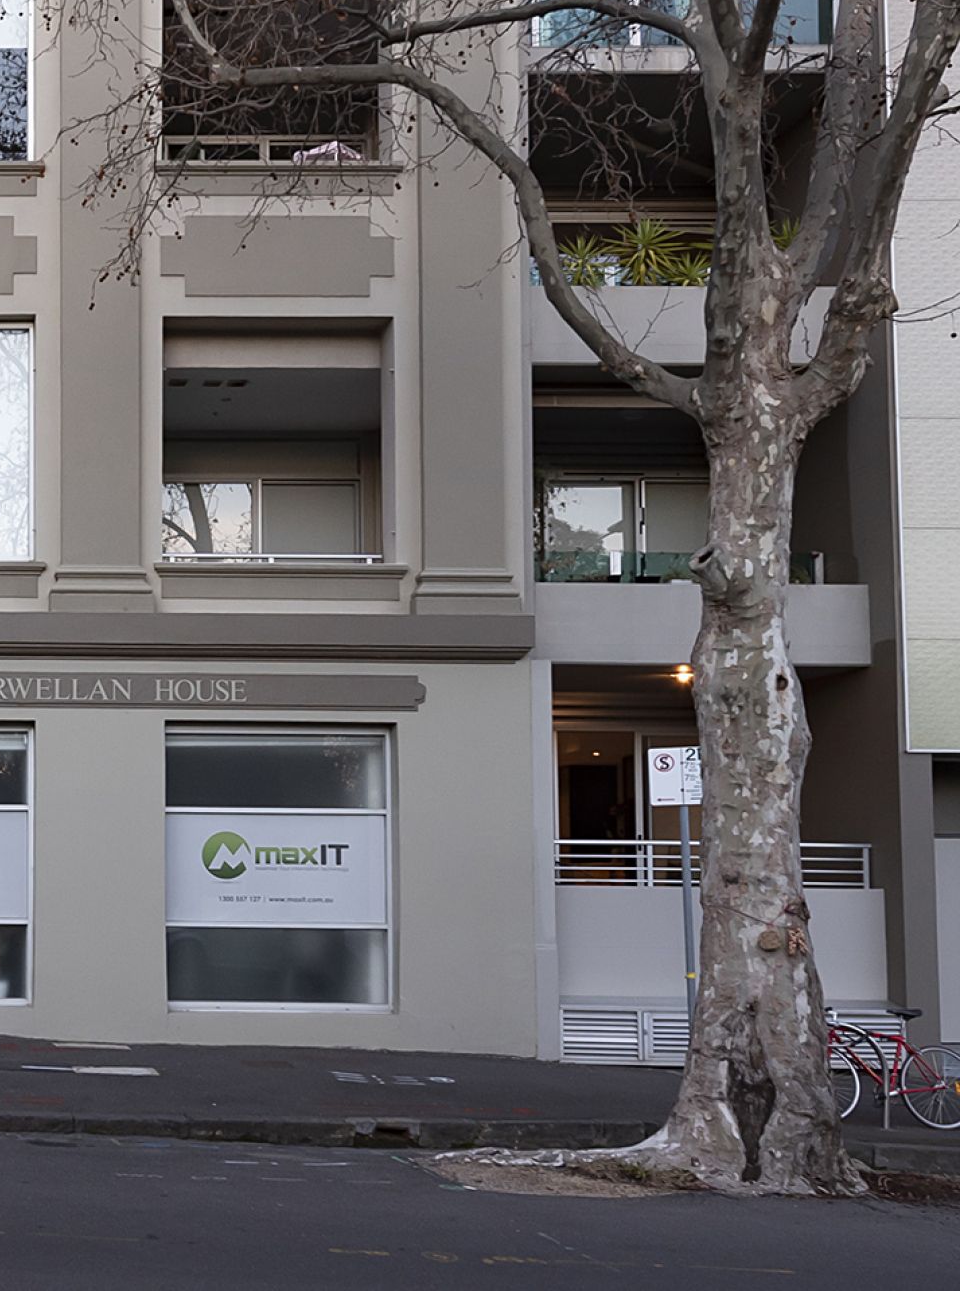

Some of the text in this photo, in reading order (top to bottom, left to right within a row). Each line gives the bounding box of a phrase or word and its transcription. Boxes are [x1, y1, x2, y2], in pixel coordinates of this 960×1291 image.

[154, 678, 248, 703] HOUSE
[685, 748, 702, 761] 2
[254, 843, 350, 866] maxIT
